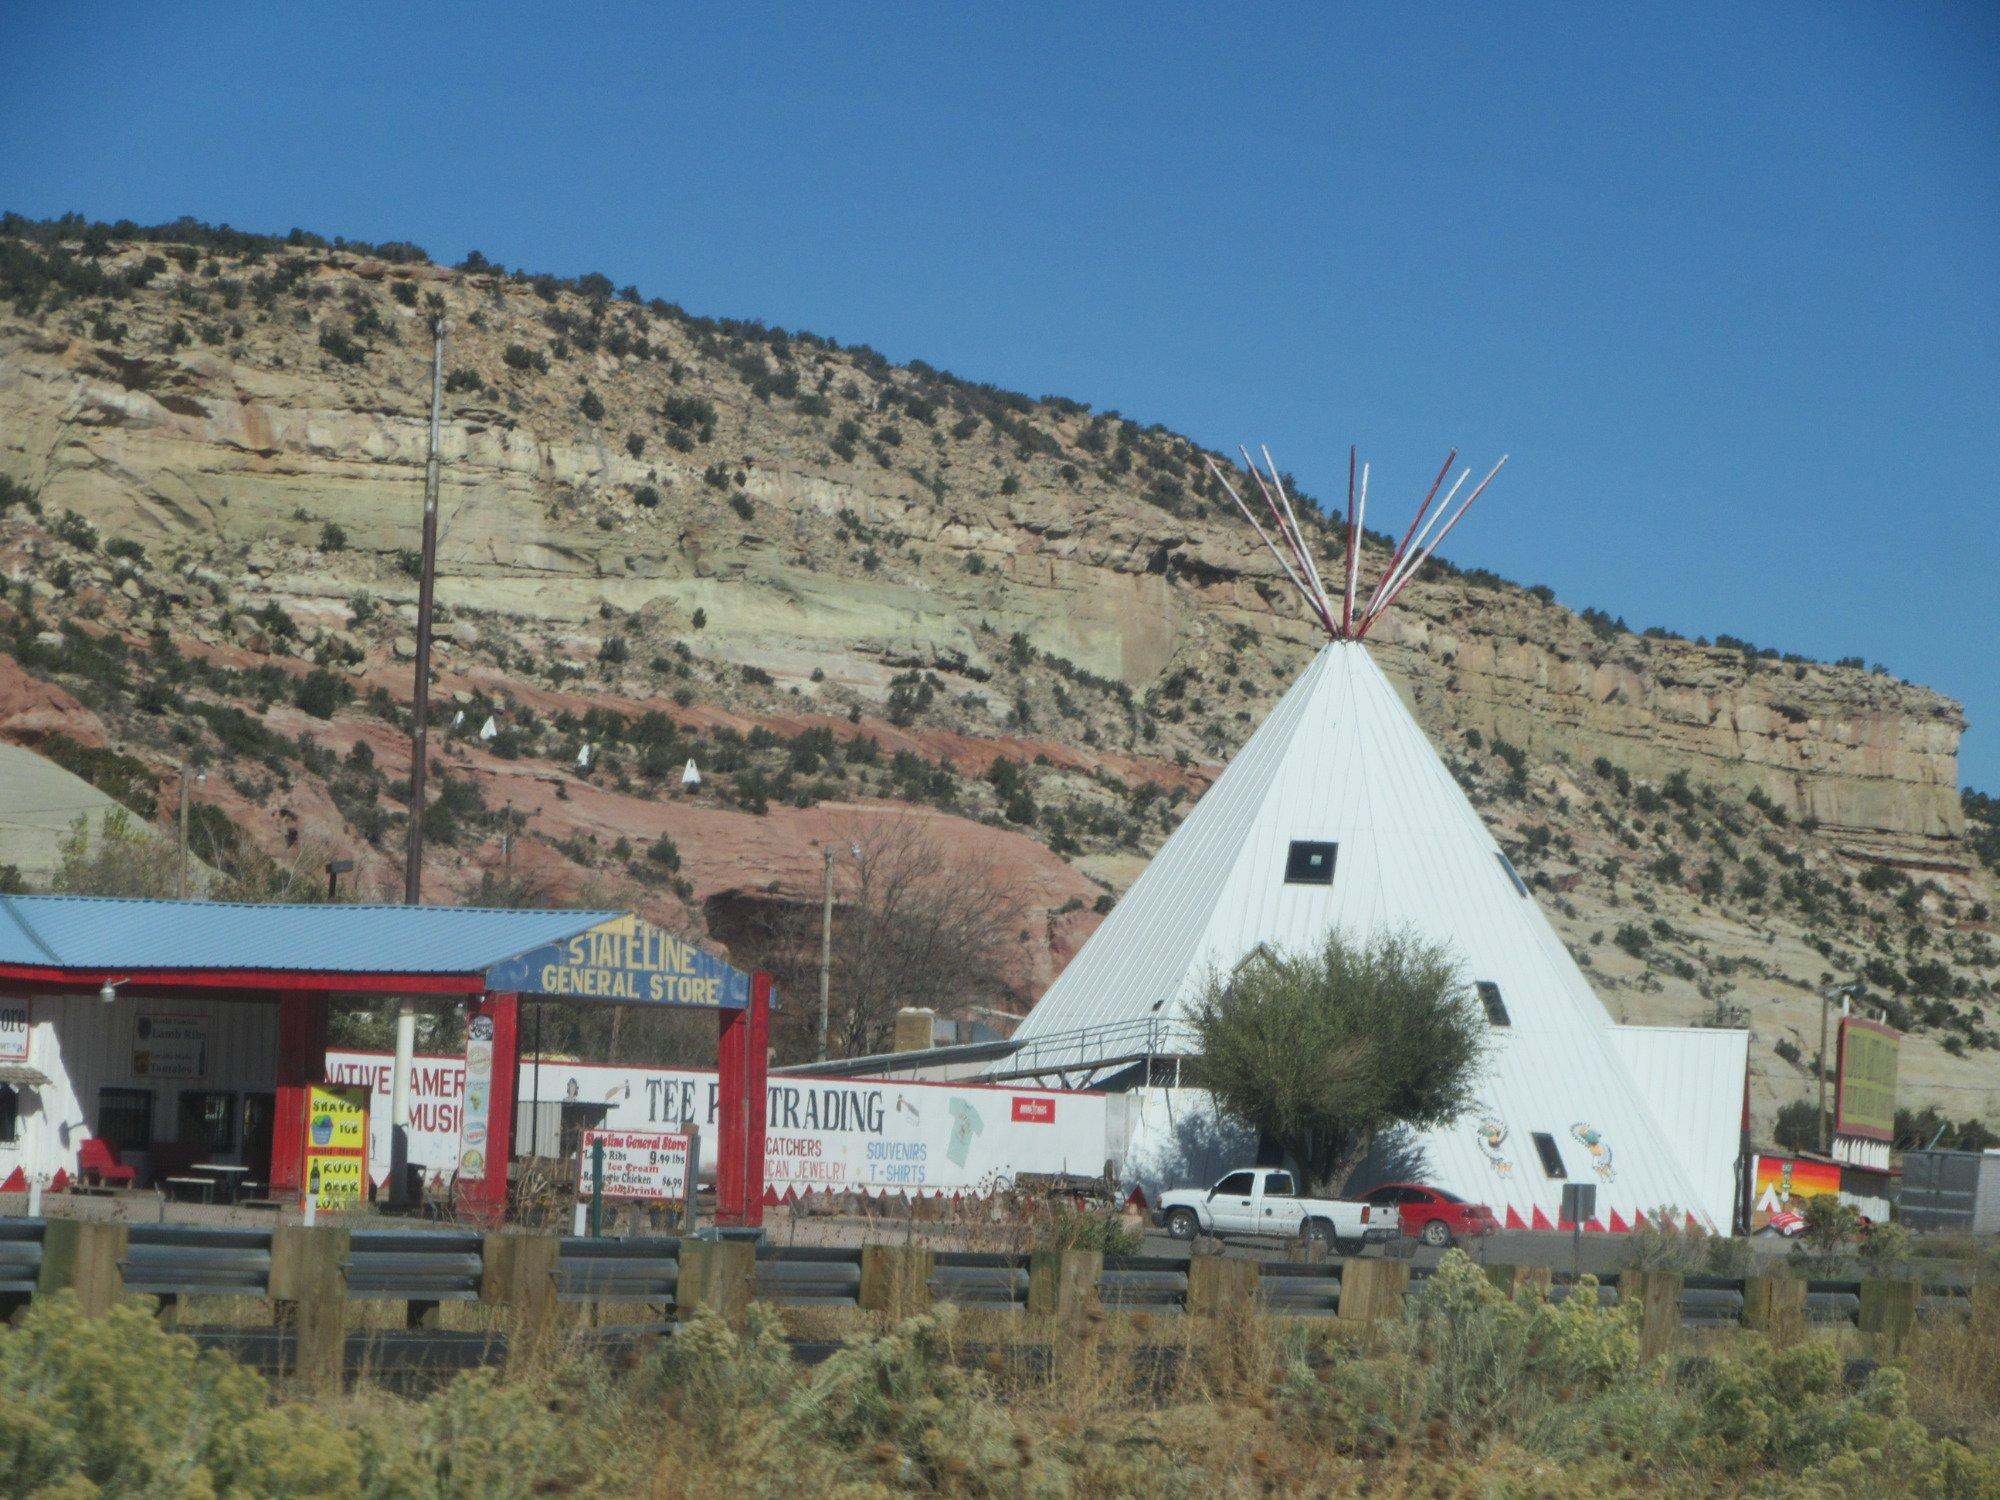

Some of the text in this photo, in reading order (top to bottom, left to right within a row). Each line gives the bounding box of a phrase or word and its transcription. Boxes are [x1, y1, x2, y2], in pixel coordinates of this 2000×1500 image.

[568, 919, 697, 975] STATELINE
[541, 964, 720, 1005] GENERAL STORE
[0, 1008, 26, 1033] ore
[324, 1062, 392, 1095] NATIVE
[646, 1077, 696, 1124] TEE
[767, 1084, 886, 1135] TRADING
[626, 1135, 660, 1150] General
[662, 1136, 687, 1151] Store
[766, 1137, 822, 1157] CATCHERS
[867, 1141, 927, 1161] SOUVENIRS
[608, 1150, 627, 1162] Ribs
[649, 1151, 685, 1165] 9.99 lbs
[607, 1163, 659, 1174] Ice Cream
[621, 1173, 652, 1184] Chicken
[794, 1160, 847, 1180] JEWELRY
